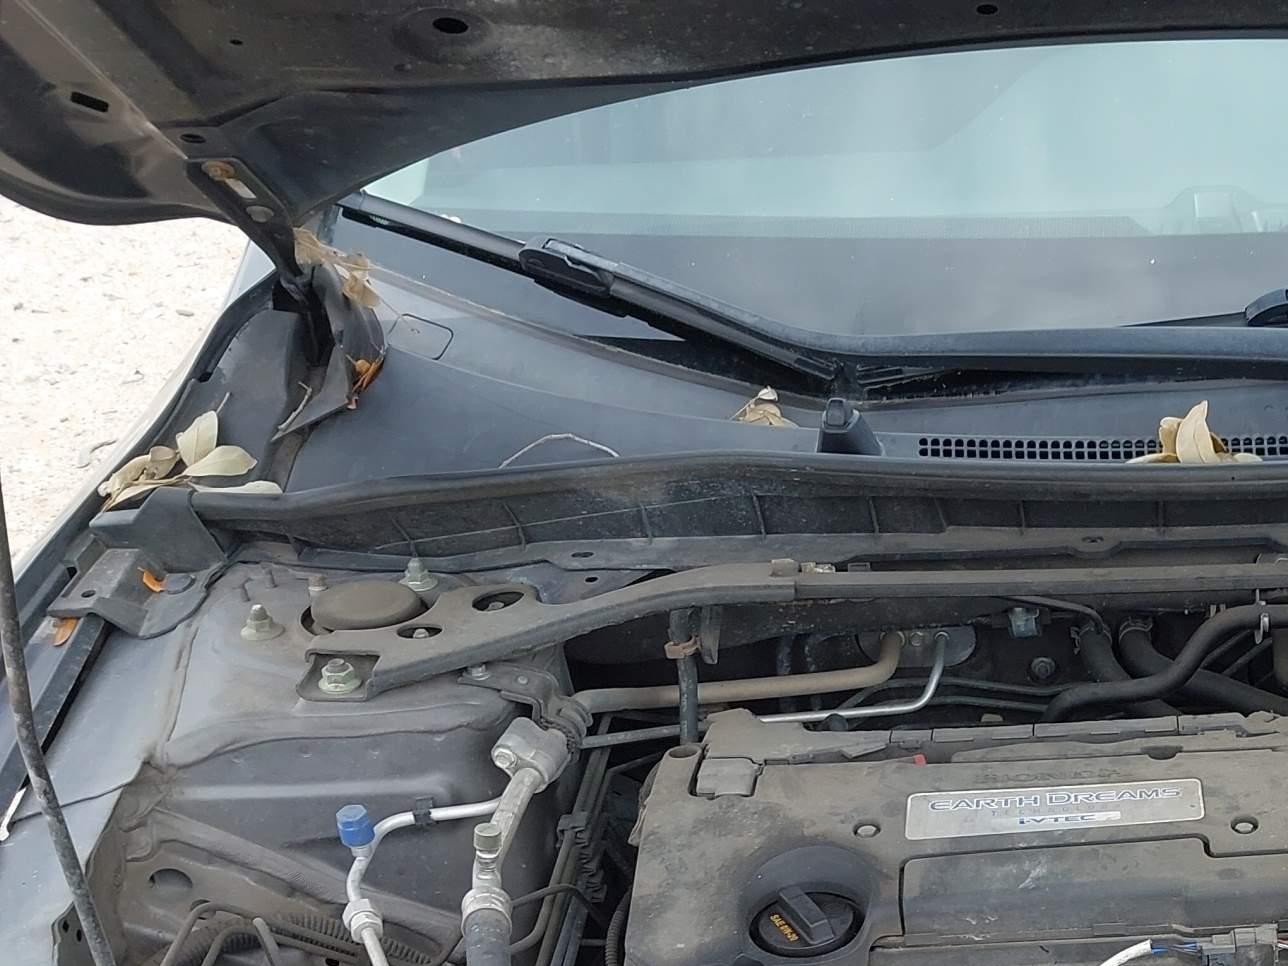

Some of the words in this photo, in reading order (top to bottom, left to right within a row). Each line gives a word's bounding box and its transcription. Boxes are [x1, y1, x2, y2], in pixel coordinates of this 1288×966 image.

[928, 795, 1039, 812] EARTH
[1046, 787, 1181, 806] DREAMS
[769, 914, 786, 927] SAE
